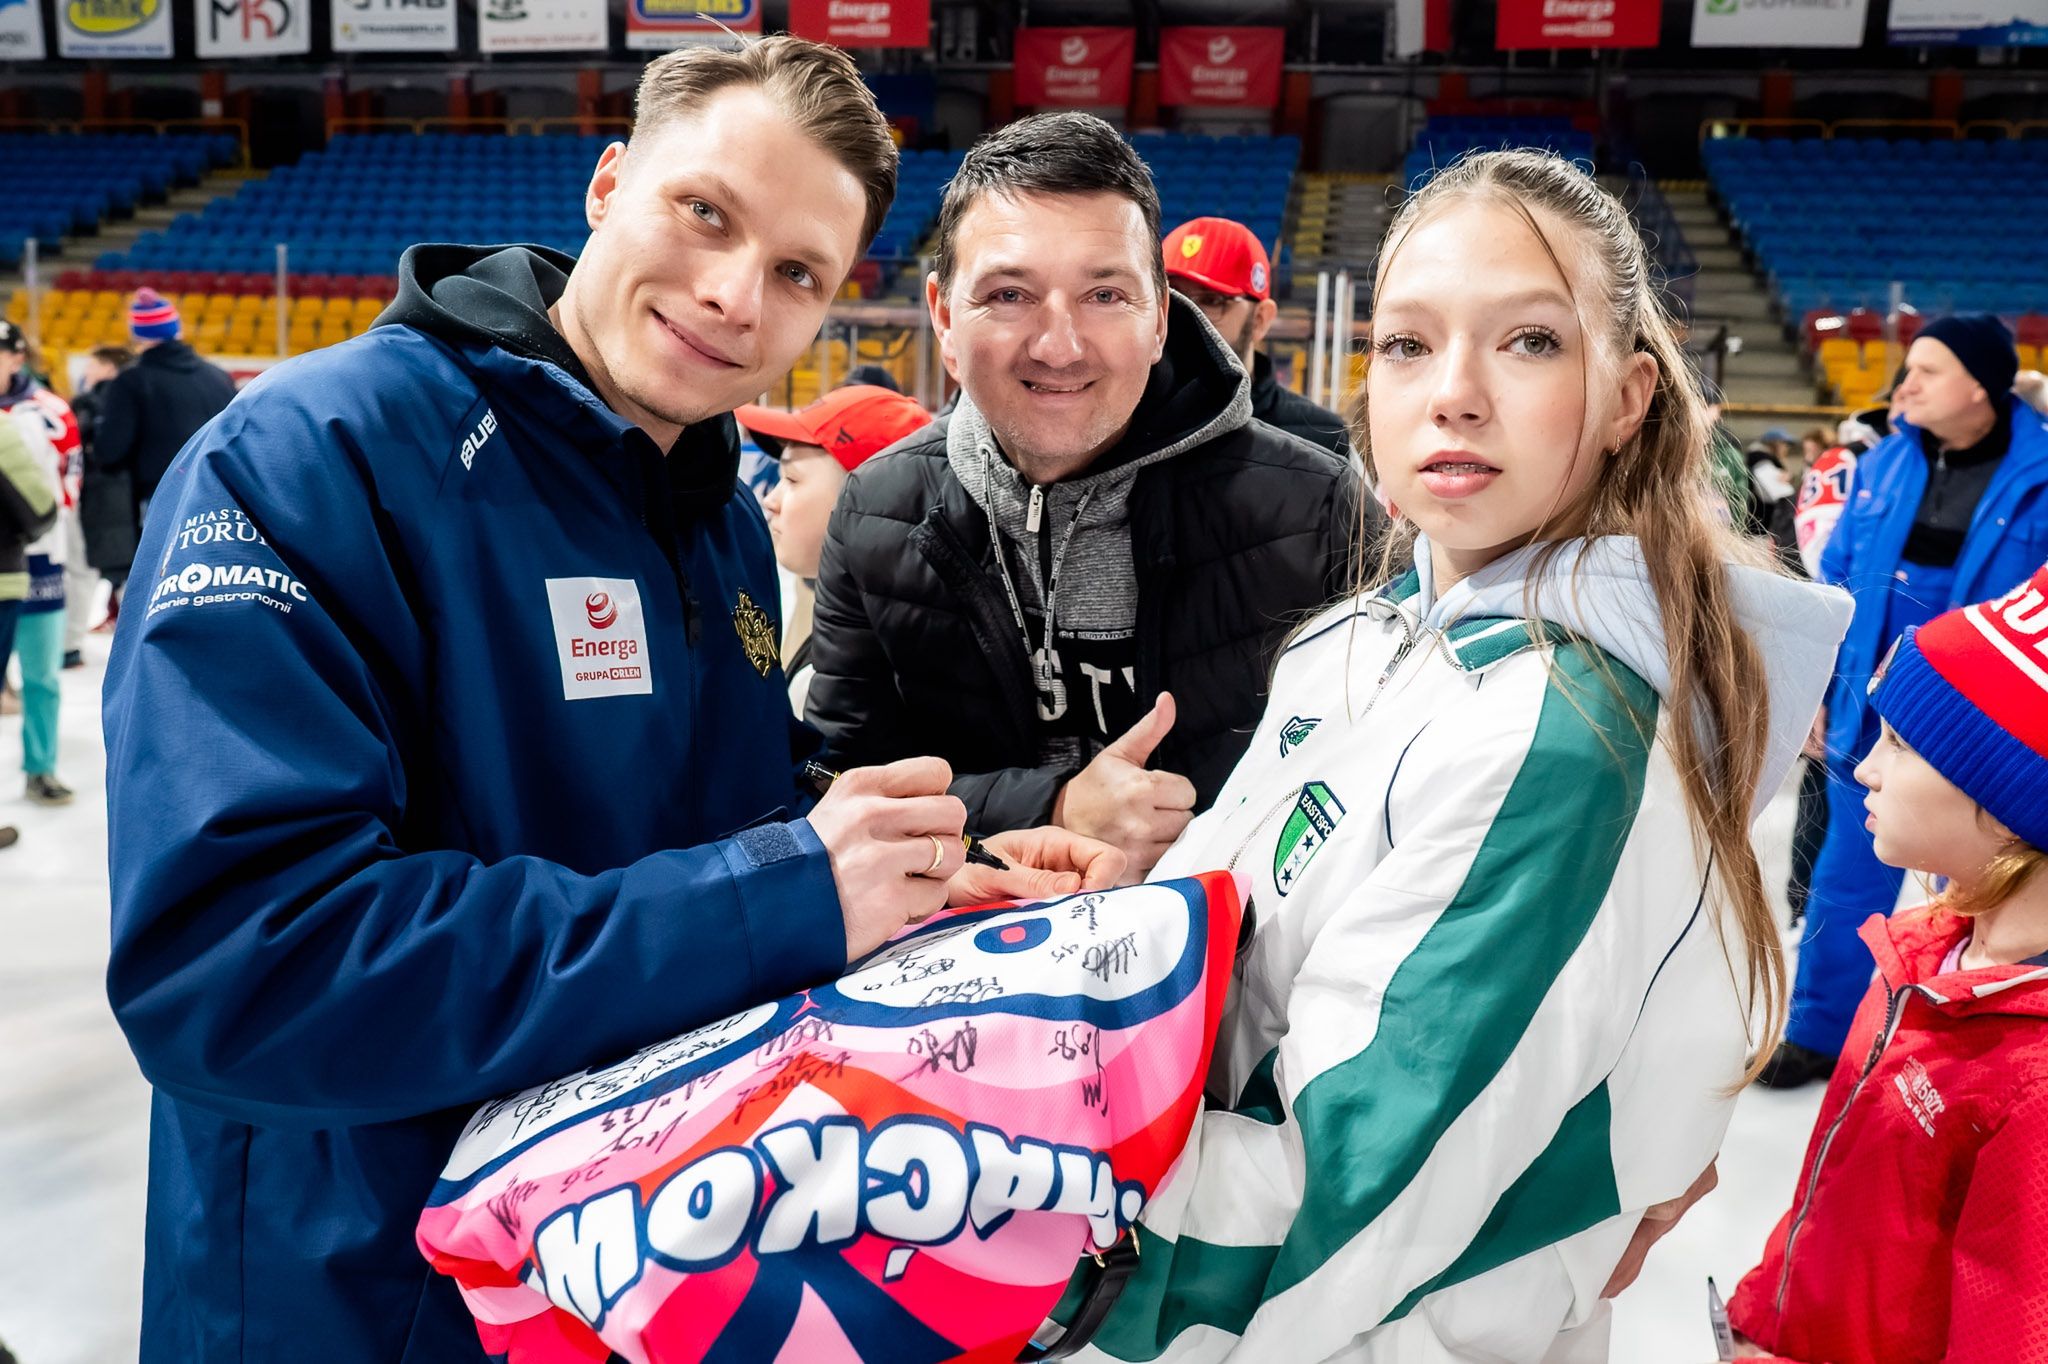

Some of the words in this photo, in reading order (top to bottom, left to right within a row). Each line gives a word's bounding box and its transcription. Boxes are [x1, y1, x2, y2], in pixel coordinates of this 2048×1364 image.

[185, 508, 252, 530] MIAST
[180, 521, 268, 550] TORU
[193, 592, 292, 614] gastronomii
[571, 638, 638, 660] Energa
[576, 671, 609, 682] GRUPA
[611, 667, 641, 680] ORLEN
